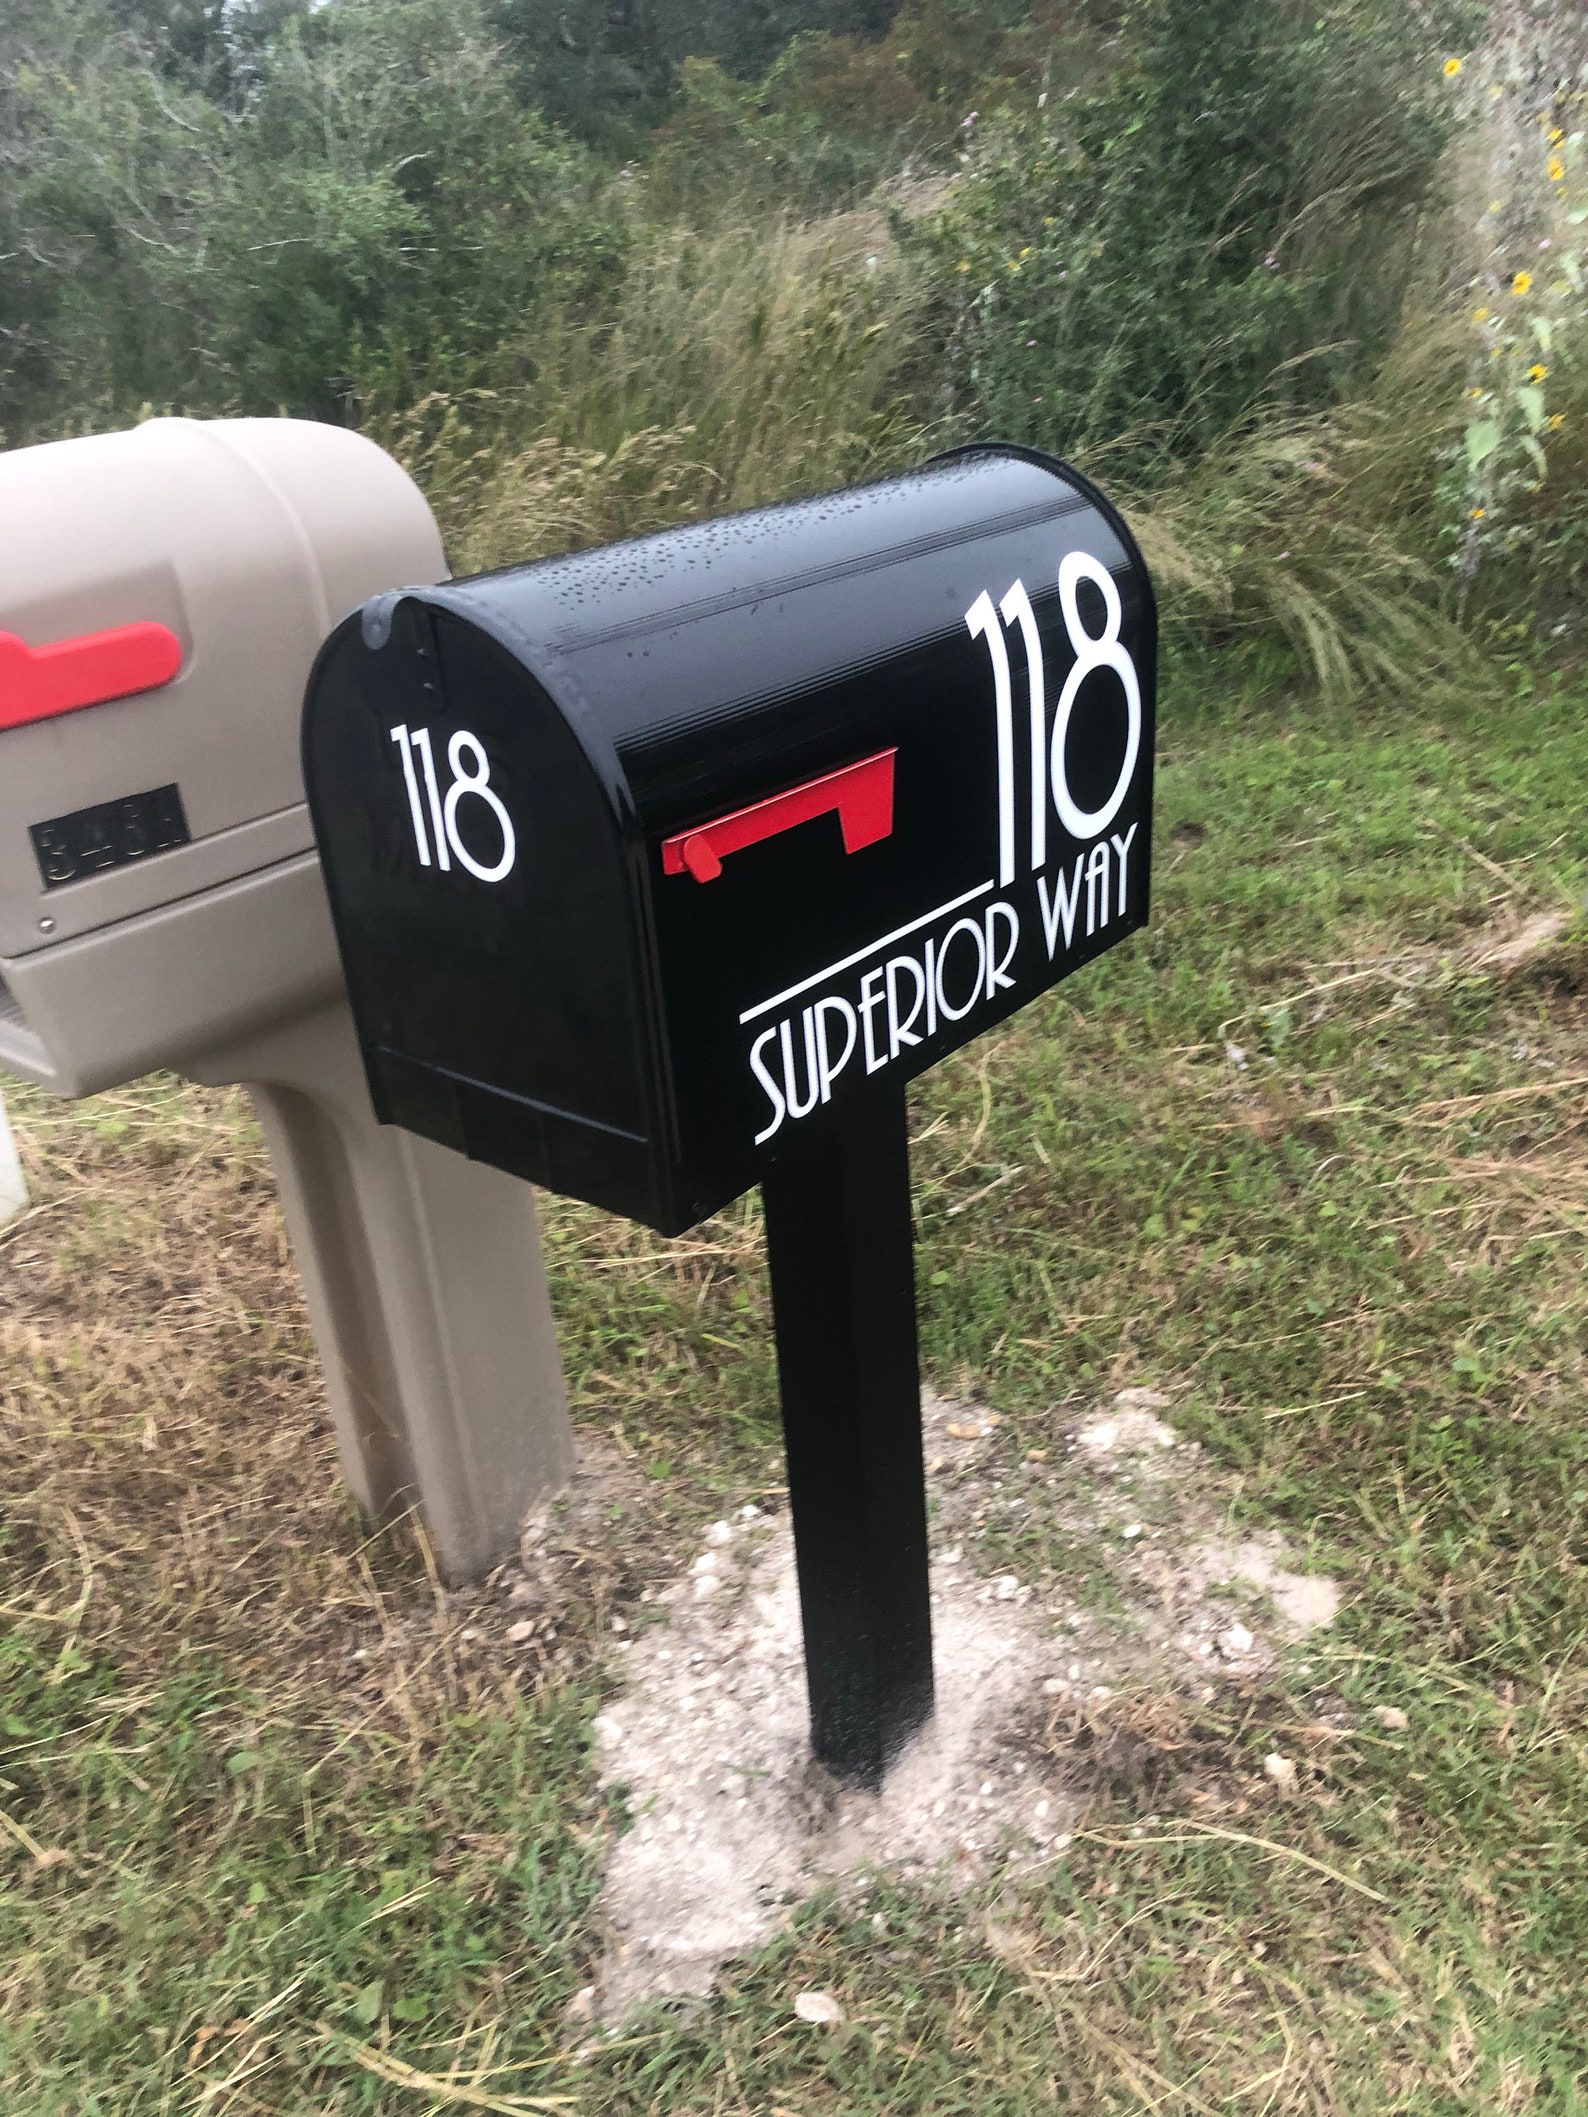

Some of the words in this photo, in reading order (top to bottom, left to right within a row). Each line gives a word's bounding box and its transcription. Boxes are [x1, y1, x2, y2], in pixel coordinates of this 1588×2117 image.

[390, 724, 516, 883] 118
[964, 551, 1142, 889] 118
[749, 901, 1020, 1146] SUPERIOR
[1036, 822, 1139, 961] WAY
